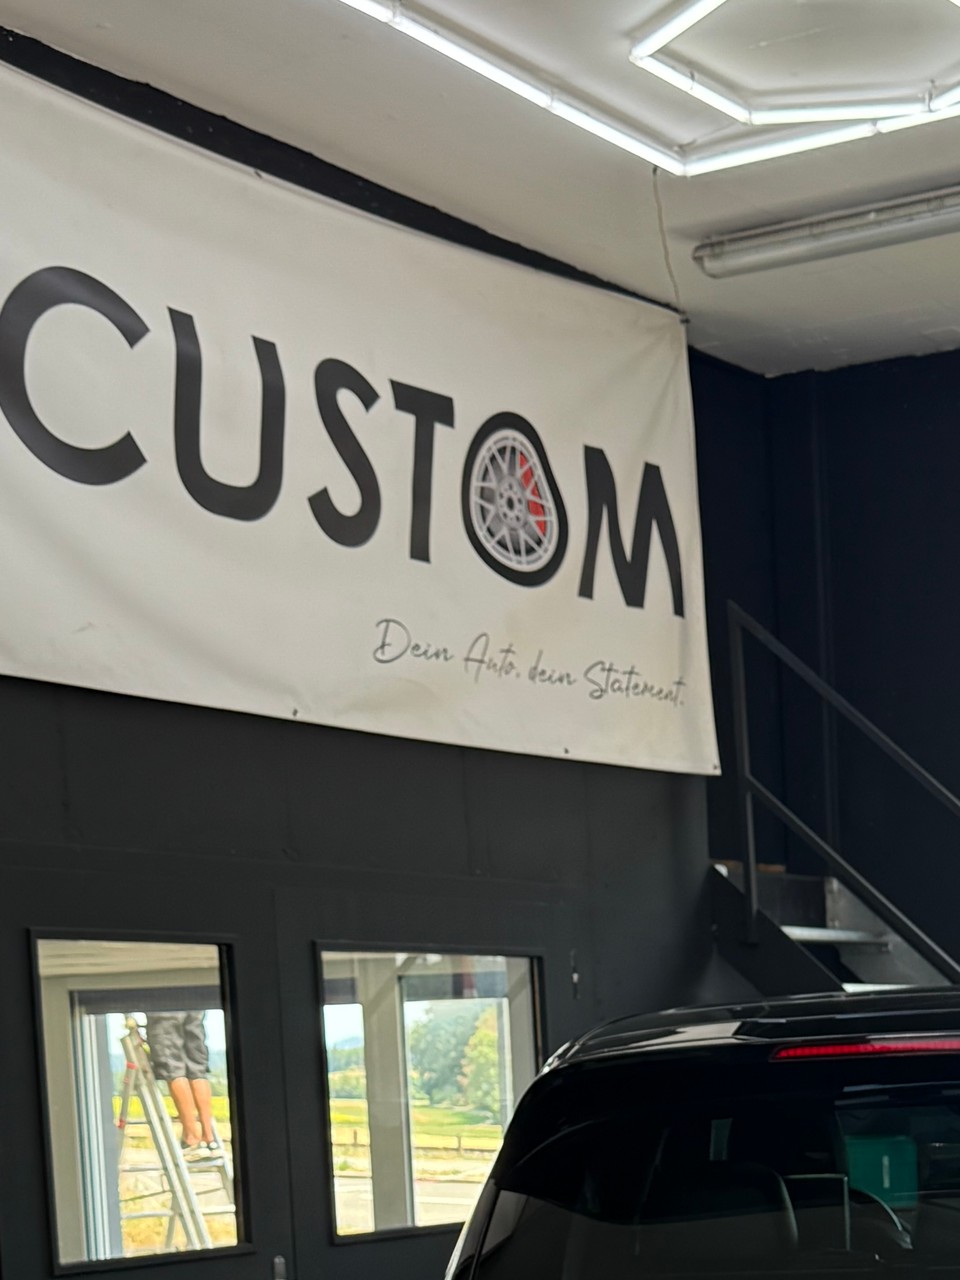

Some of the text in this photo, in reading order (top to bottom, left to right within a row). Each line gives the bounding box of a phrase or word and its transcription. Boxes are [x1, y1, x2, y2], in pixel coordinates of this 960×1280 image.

[0, 266, 685, 619] CUSTOM
[373, 618, 454, 664] Dein
[527, 649, 577, 685] dein
